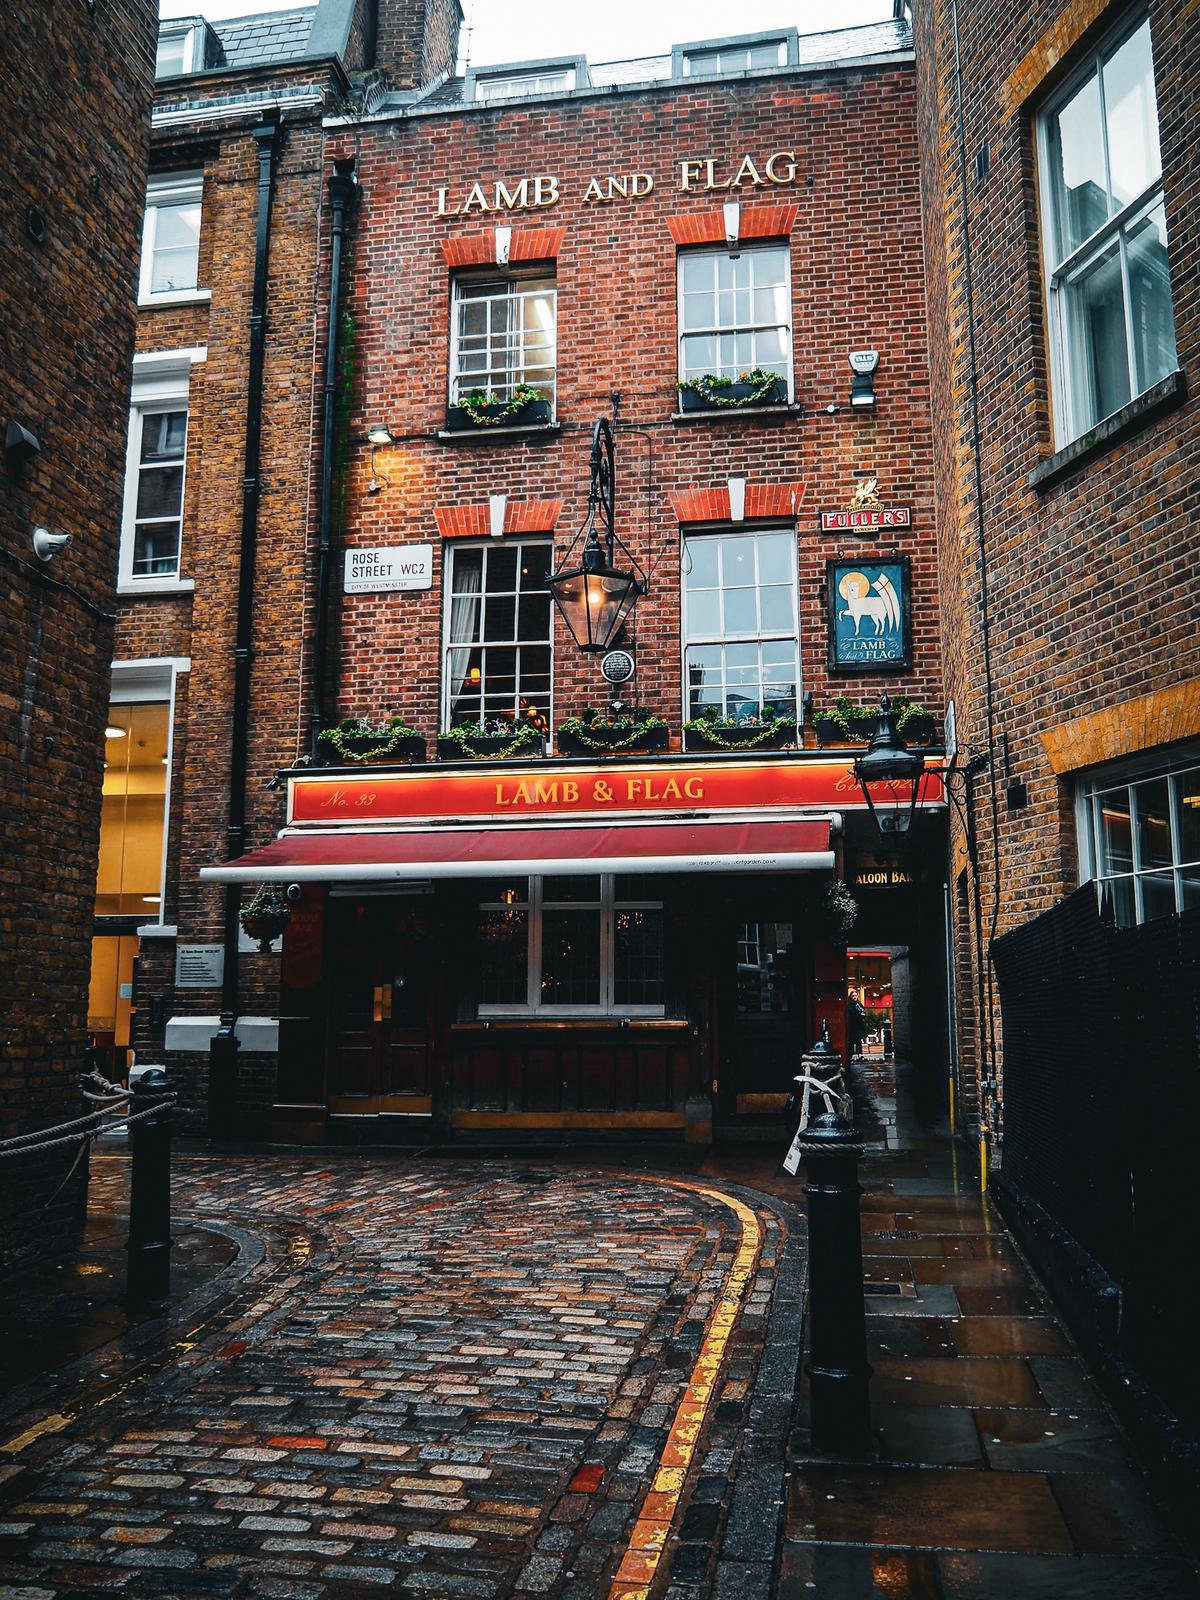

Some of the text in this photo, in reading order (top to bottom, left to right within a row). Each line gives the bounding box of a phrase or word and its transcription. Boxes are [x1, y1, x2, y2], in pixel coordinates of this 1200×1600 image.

[435, 151, 799, 218] LAMB AND FLAG
[826, 511, 905, 527] FULLER'S
[352, 552, 380, 565] ROSE
[351, 563, 425, 578] STREET WC2
[853, 641, 886, 650] LAMB
[865, 650, 896, 659] FLAG
[320, 790, 377, 807] No. 33
[495, 777, 704, 805] LAMB & FLAG
[855, 872, 888, 884] ALOON
